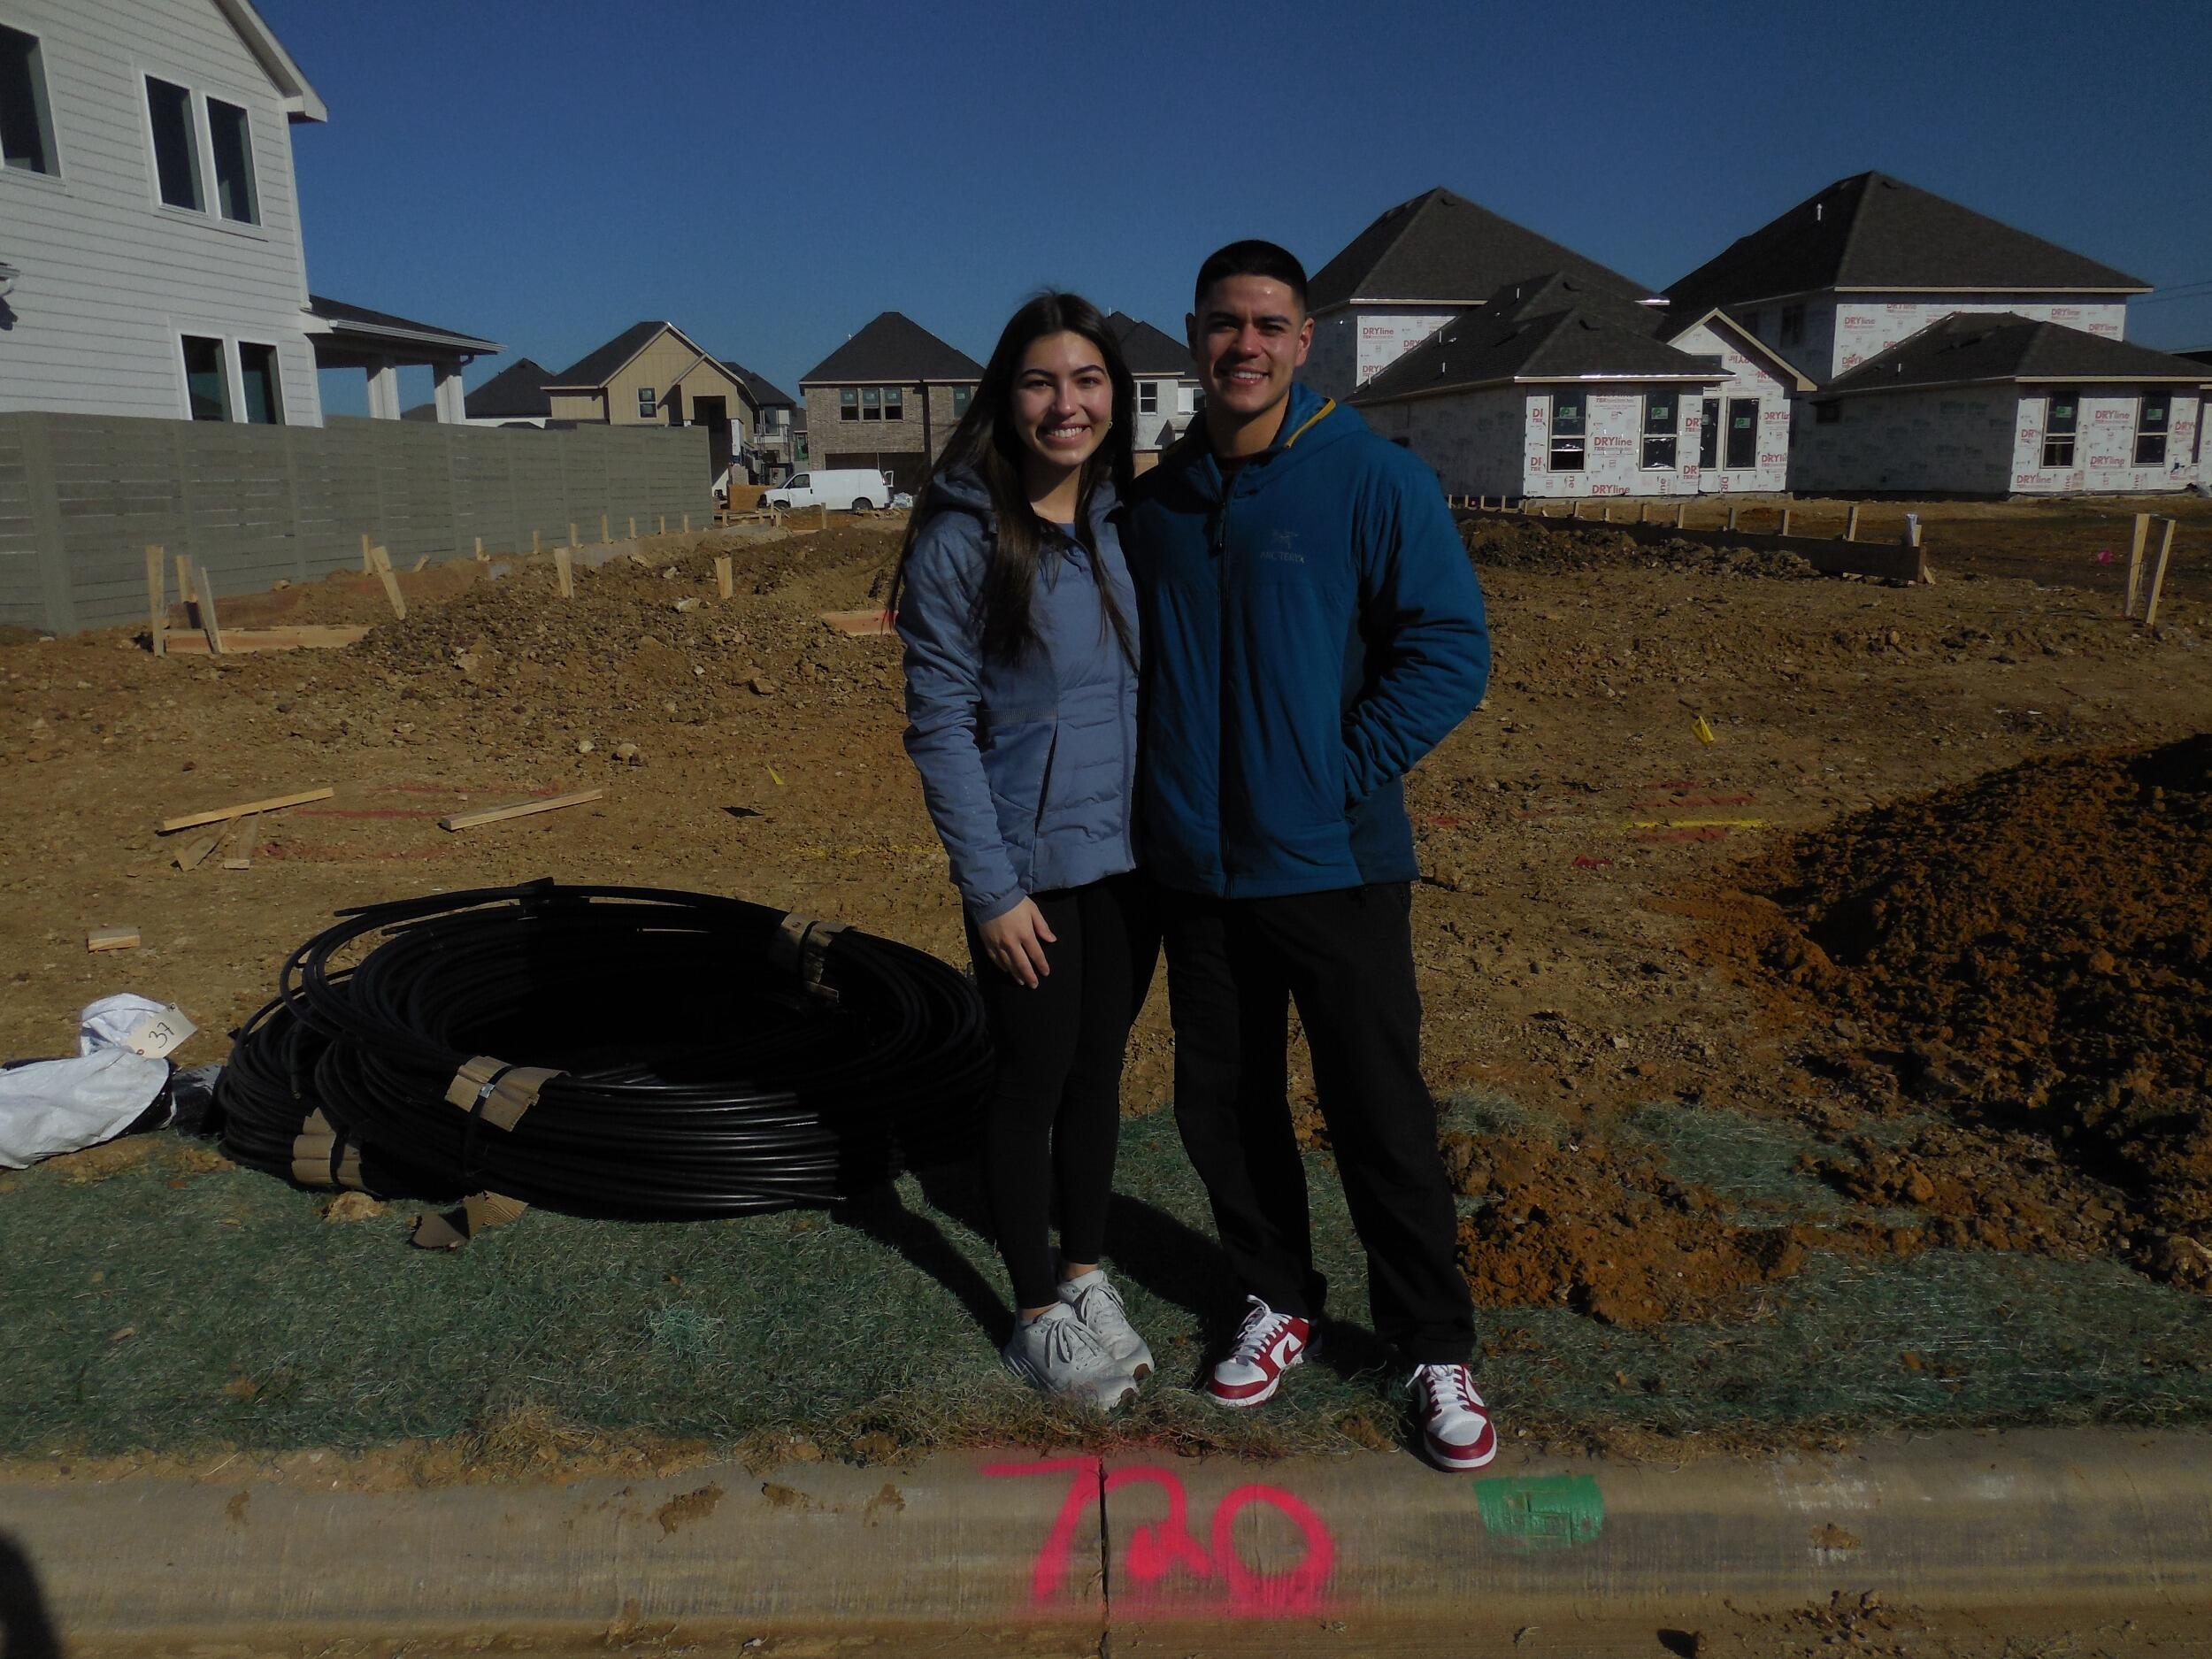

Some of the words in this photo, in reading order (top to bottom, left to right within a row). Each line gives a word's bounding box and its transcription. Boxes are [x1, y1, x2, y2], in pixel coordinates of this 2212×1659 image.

[2095, 411, 2130, 419] DRYline
[1594, 436, 1632, 446] DRYline
[1592, 485, 1631, 494] DRYline
[149, 1021, 176, 1048] 37
[979, 1455, 1336, 1617] 720
